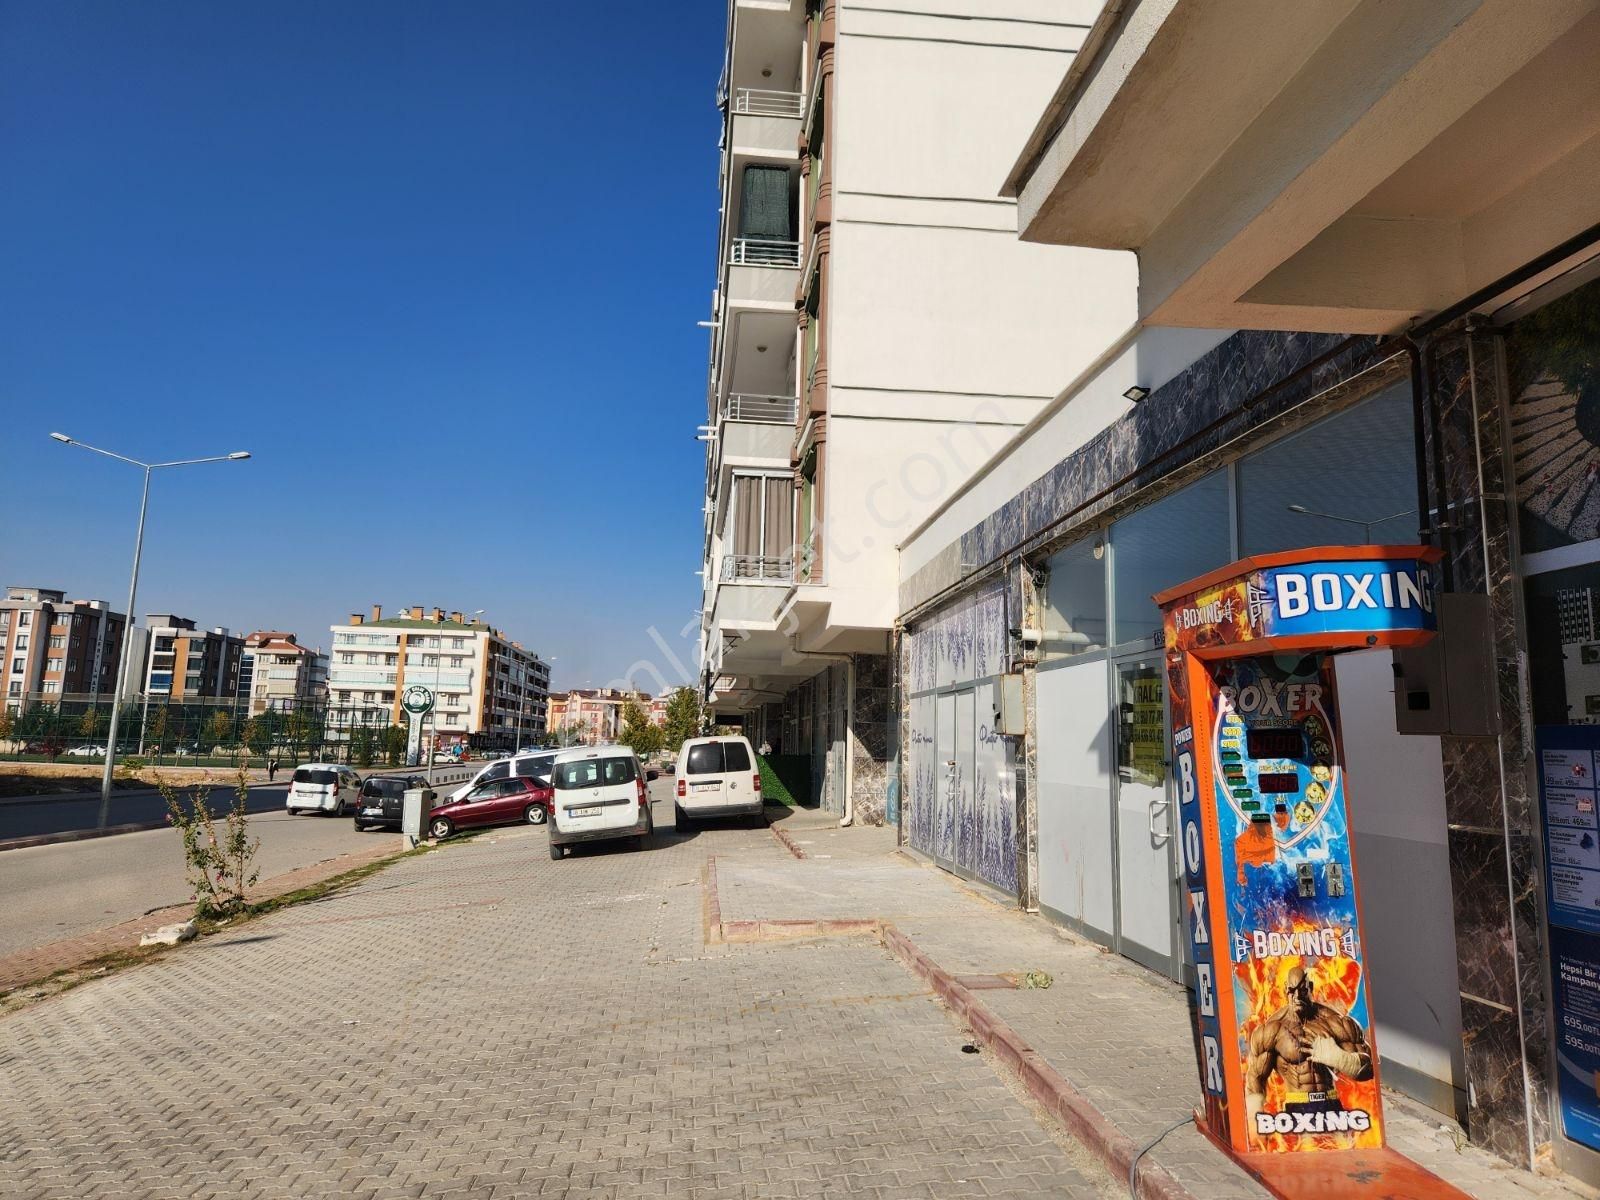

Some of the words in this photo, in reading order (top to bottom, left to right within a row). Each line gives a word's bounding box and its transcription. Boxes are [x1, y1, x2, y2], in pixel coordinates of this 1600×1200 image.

[1275, 568, 1432, 618] BOXING
[1183, 600, 1222, 630] BOXING
[1219, 678, 1323, 717] BOXER
[1178, 753, 1224, 1096] BOXER
[1254, 929, 1338, 959] BOXING
[1560, 962, 1582, 976] Hepsi
[1584, 968, 1597, 979] Bir
[1256, 1110, 1370, 1135] BOXING
